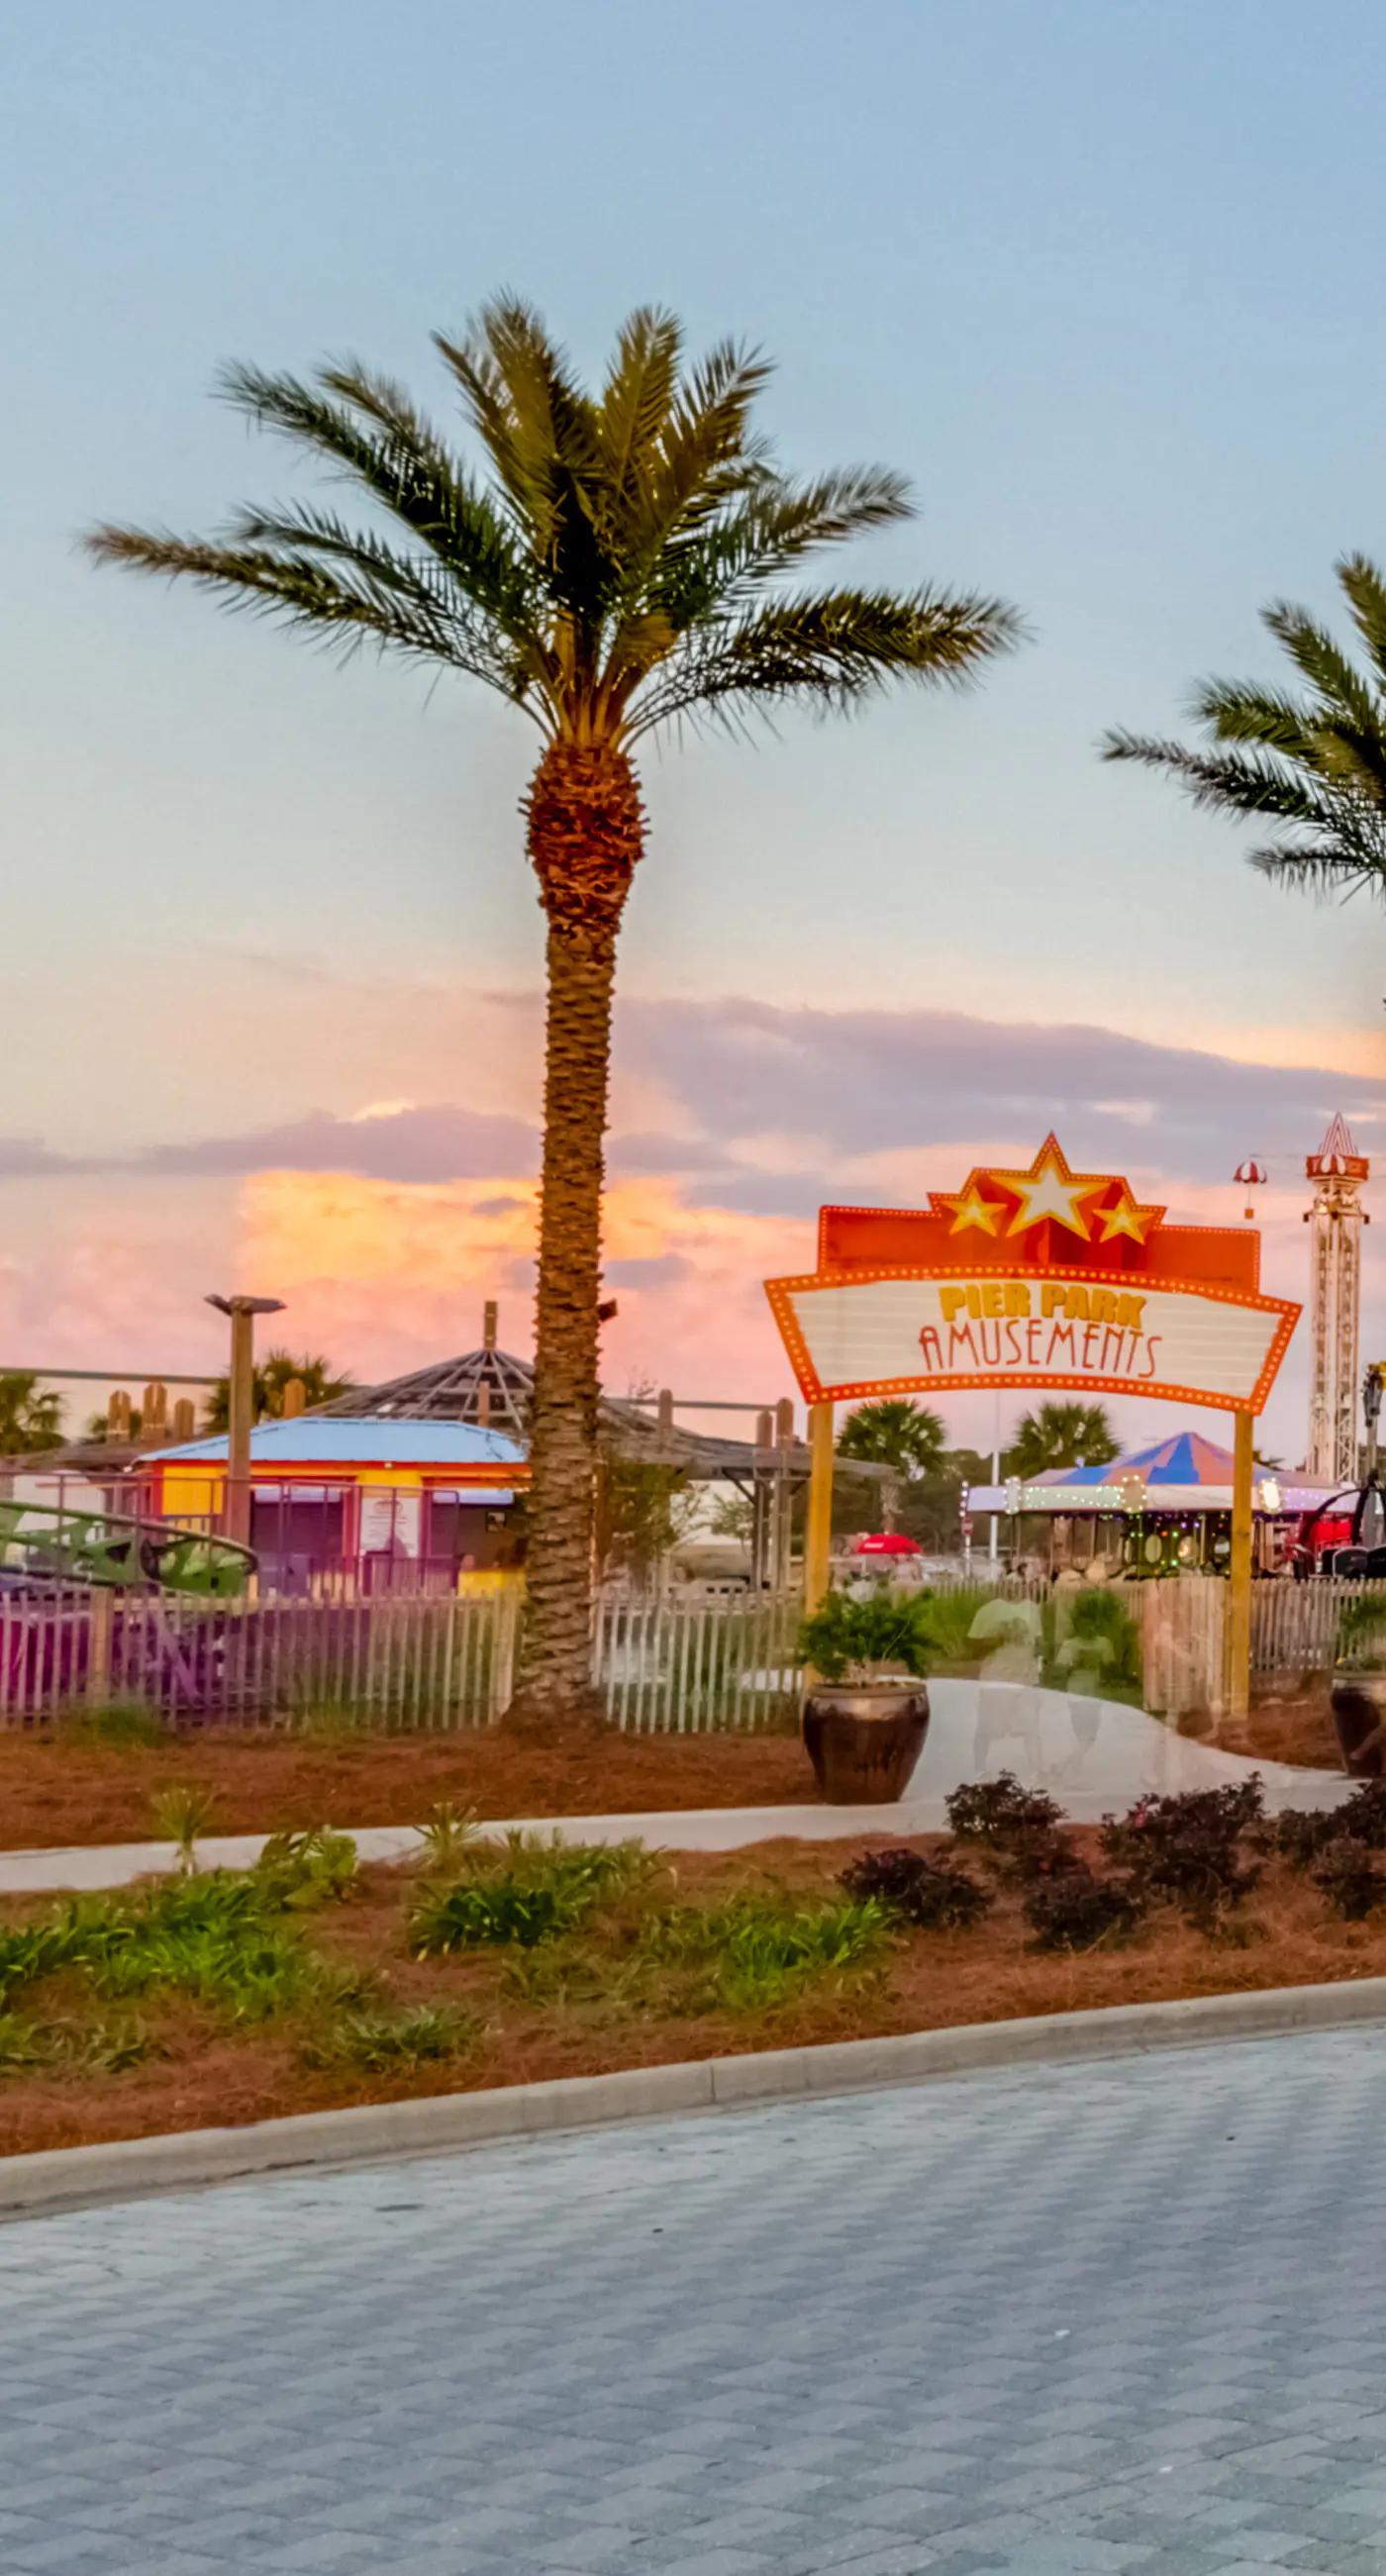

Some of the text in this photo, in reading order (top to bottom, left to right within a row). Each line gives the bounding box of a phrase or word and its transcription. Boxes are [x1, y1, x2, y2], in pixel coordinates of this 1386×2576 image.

[939, 1283, 1146, 1329] PIER PARK
[918, 1319, 1163, 1378] AMUSEMENTS
